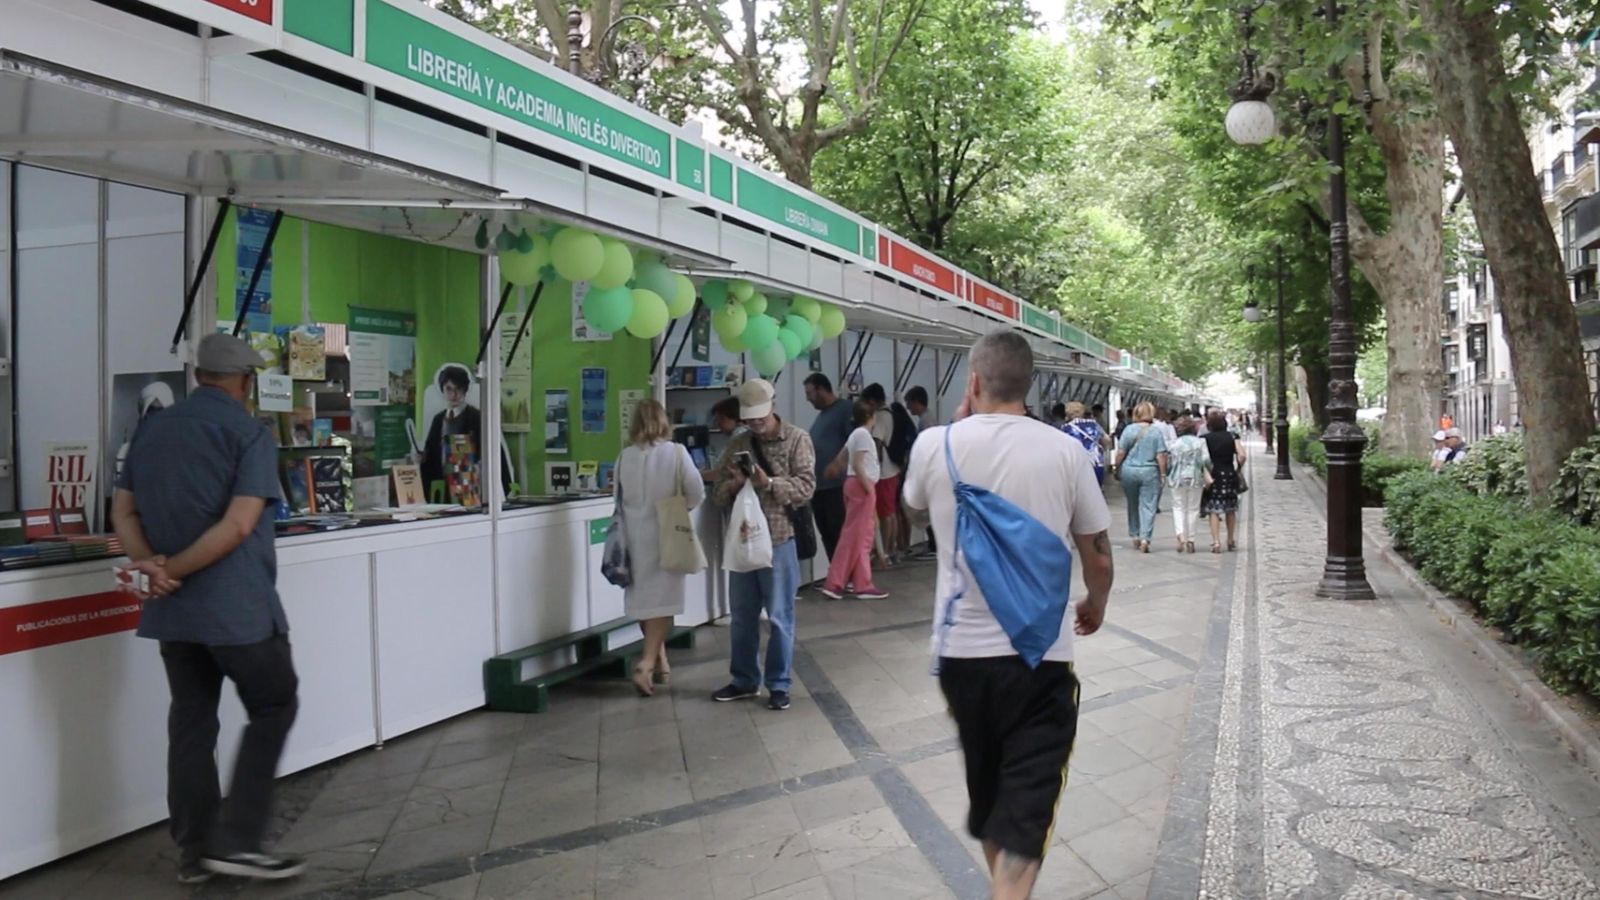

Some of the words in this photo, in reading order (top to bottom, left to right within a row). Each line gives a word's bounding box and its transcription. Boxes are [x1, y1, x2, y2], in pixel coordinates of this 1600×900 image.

[407, 44, 482, 97] LIBRERÍA
[485, 77, 495, 99] Y
[496, 83, 564, 129] ACADEMIA
[566, 111, 609, 147] INGLÉS
[610, 133, 661, 169] DIVERTIDO
[48, 454, 93, 483] RIL
[51, 484, 87, 509] KE
[16, 614, 77, 632] PUBLICACIONES
[78, 612, 89, 621] DE
[89, 610, 99, 620] LA
[100, 603, 139, 617] RESIDENCIA
